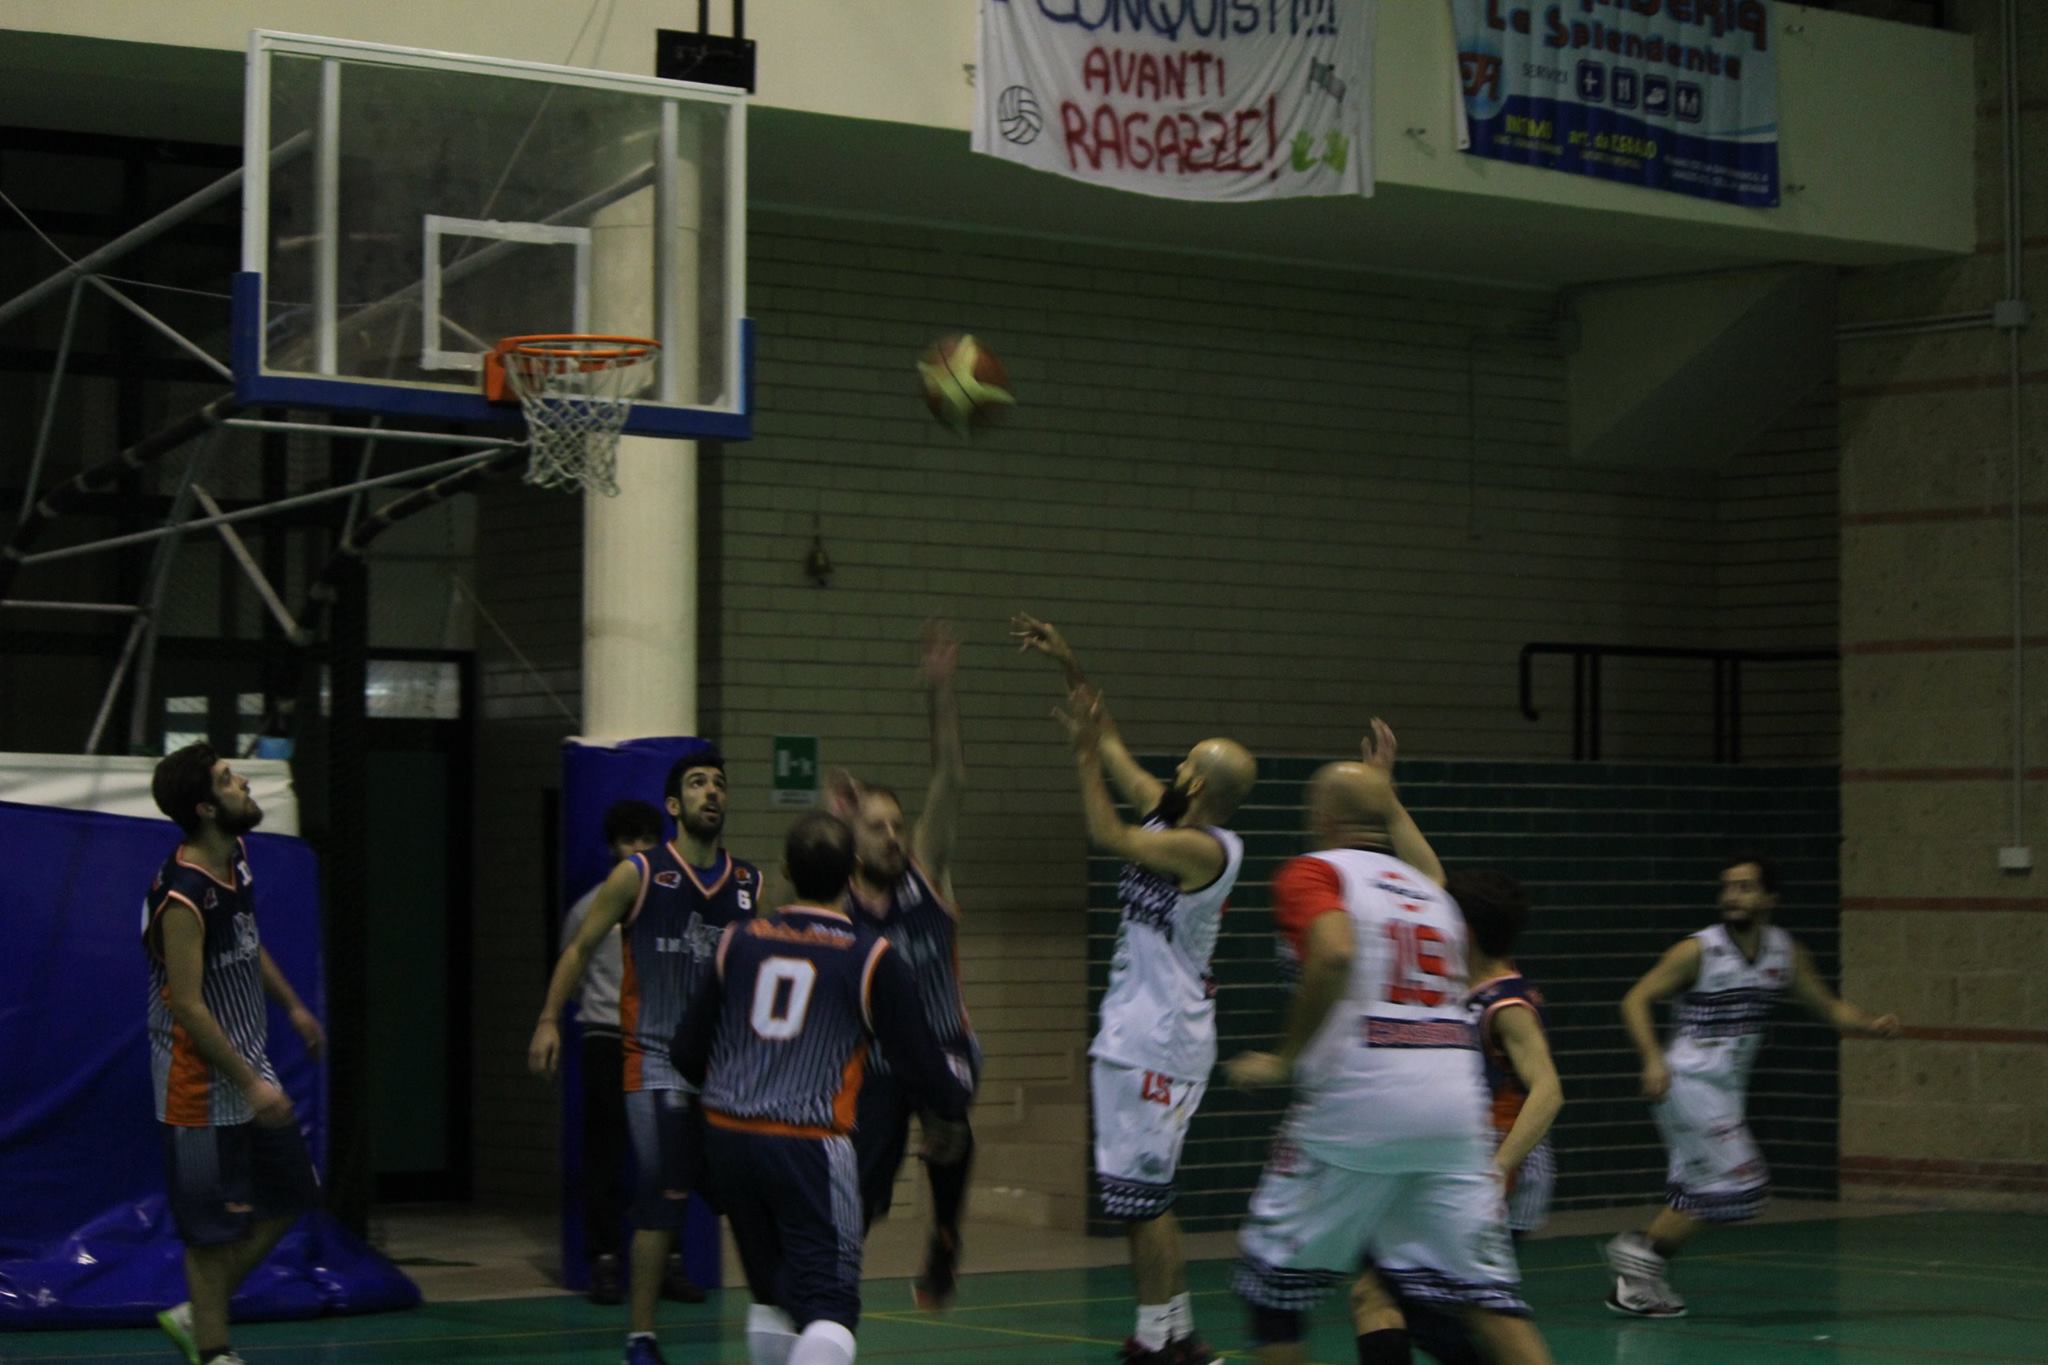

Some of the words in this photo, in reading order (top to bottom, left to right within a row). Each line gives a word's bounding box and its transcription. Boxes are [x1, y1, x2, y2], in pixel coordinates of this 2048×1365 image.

[1084, 46, 1225, 99] AVANTI
[1543, 4, 1742, 80] Splendente
[1060, 92, 1279, 180] RAGAZZE!
[736, 888, 752, 911] 6
[750, 955, 817, 1041] 0
